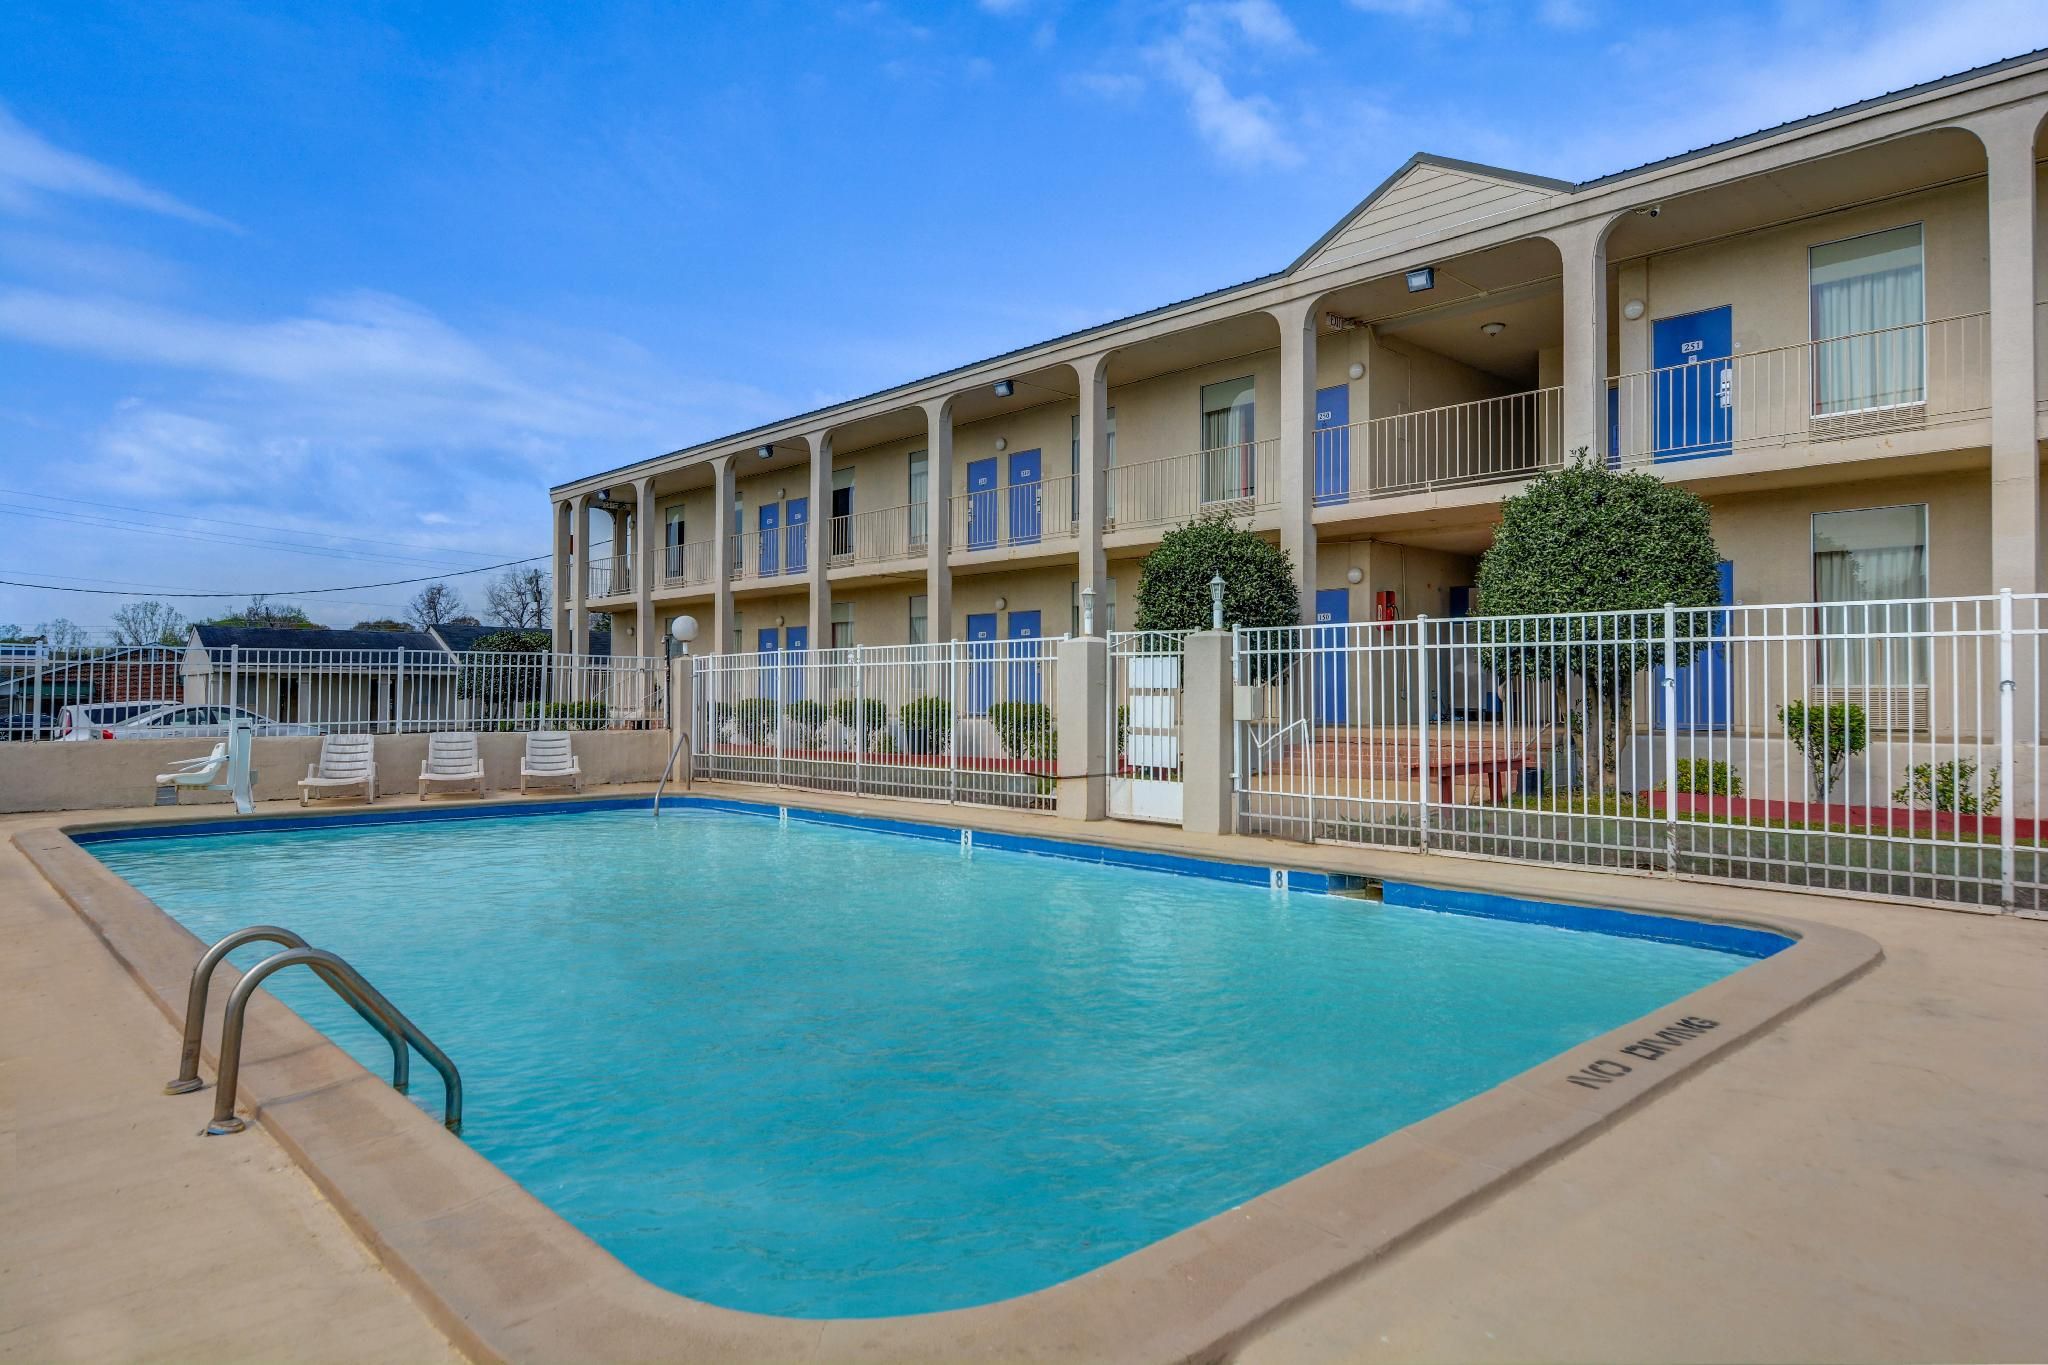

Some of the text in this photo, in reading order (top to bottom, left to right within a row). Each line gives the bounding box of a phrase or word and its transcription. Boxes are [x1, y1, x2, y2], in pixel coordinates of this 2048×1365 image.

[1684, 342, 1701, 352] 251
[1276, 870, 1283, 888] 8
[1566, 1016, 1720, 1090] NO DIVING
